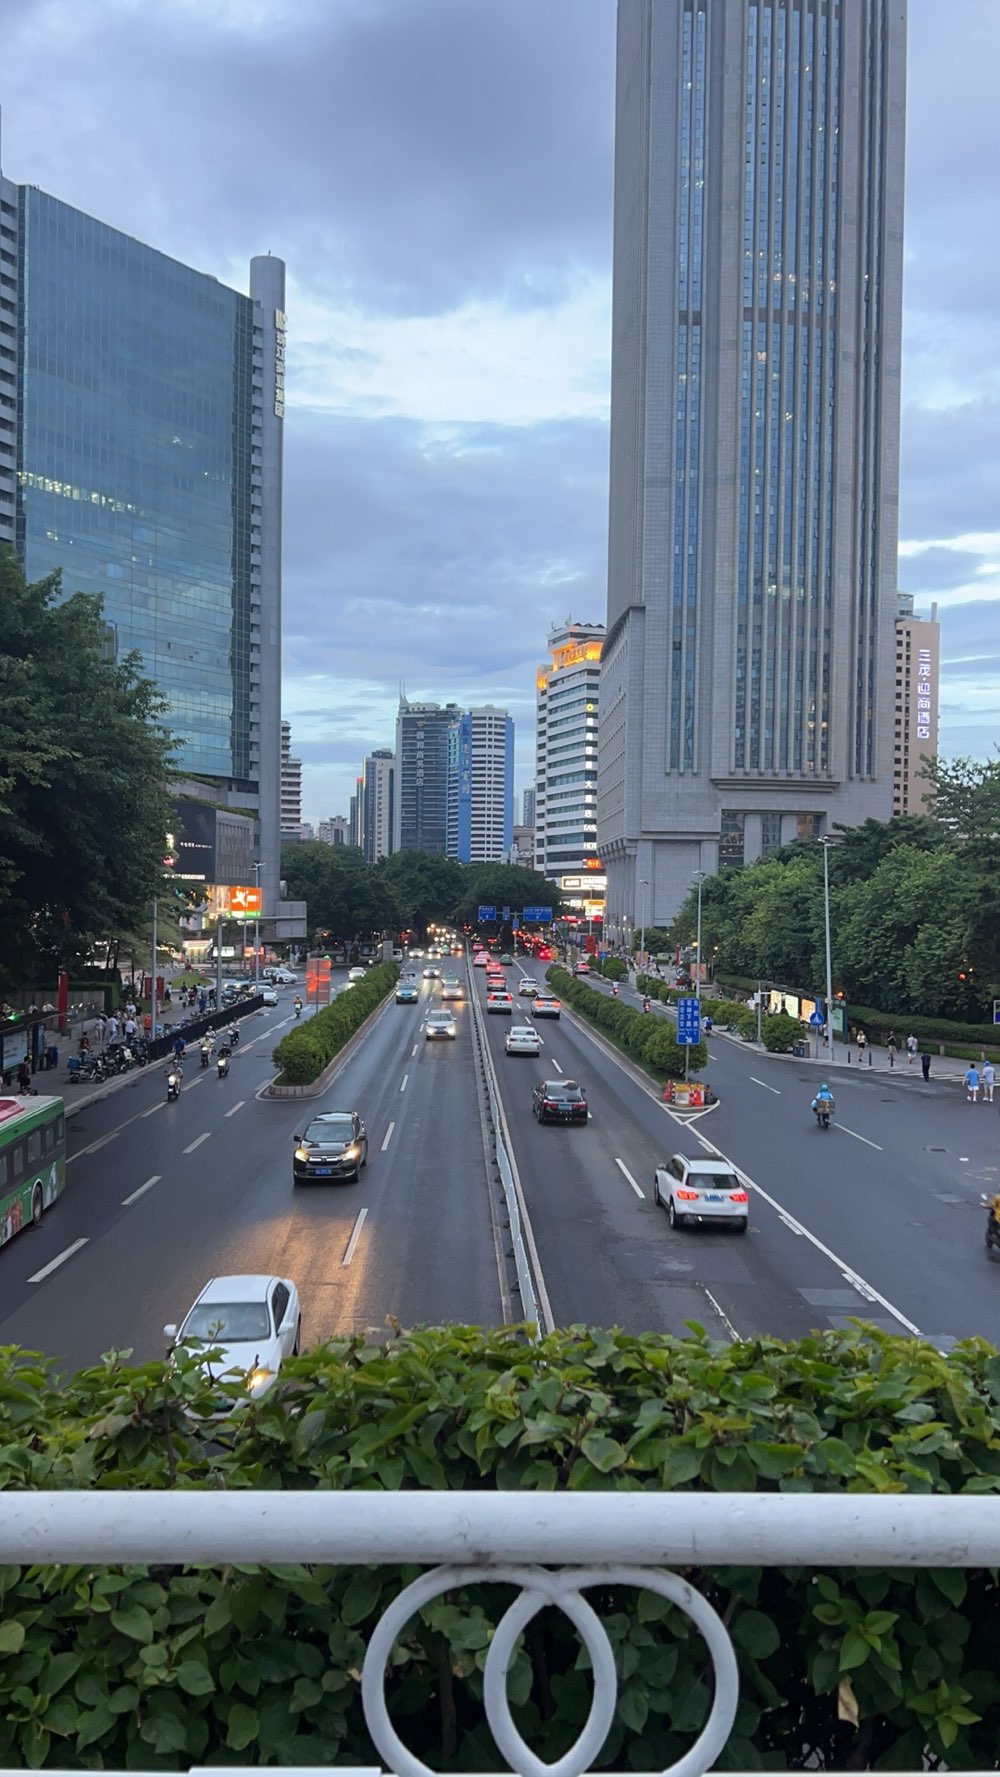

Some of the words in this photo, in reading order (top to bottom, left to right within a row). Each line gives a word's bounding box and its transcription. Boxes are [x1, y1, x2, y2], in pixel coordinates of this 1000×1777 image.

[917, 649, 931, 739] 三茂·迎商酒店
